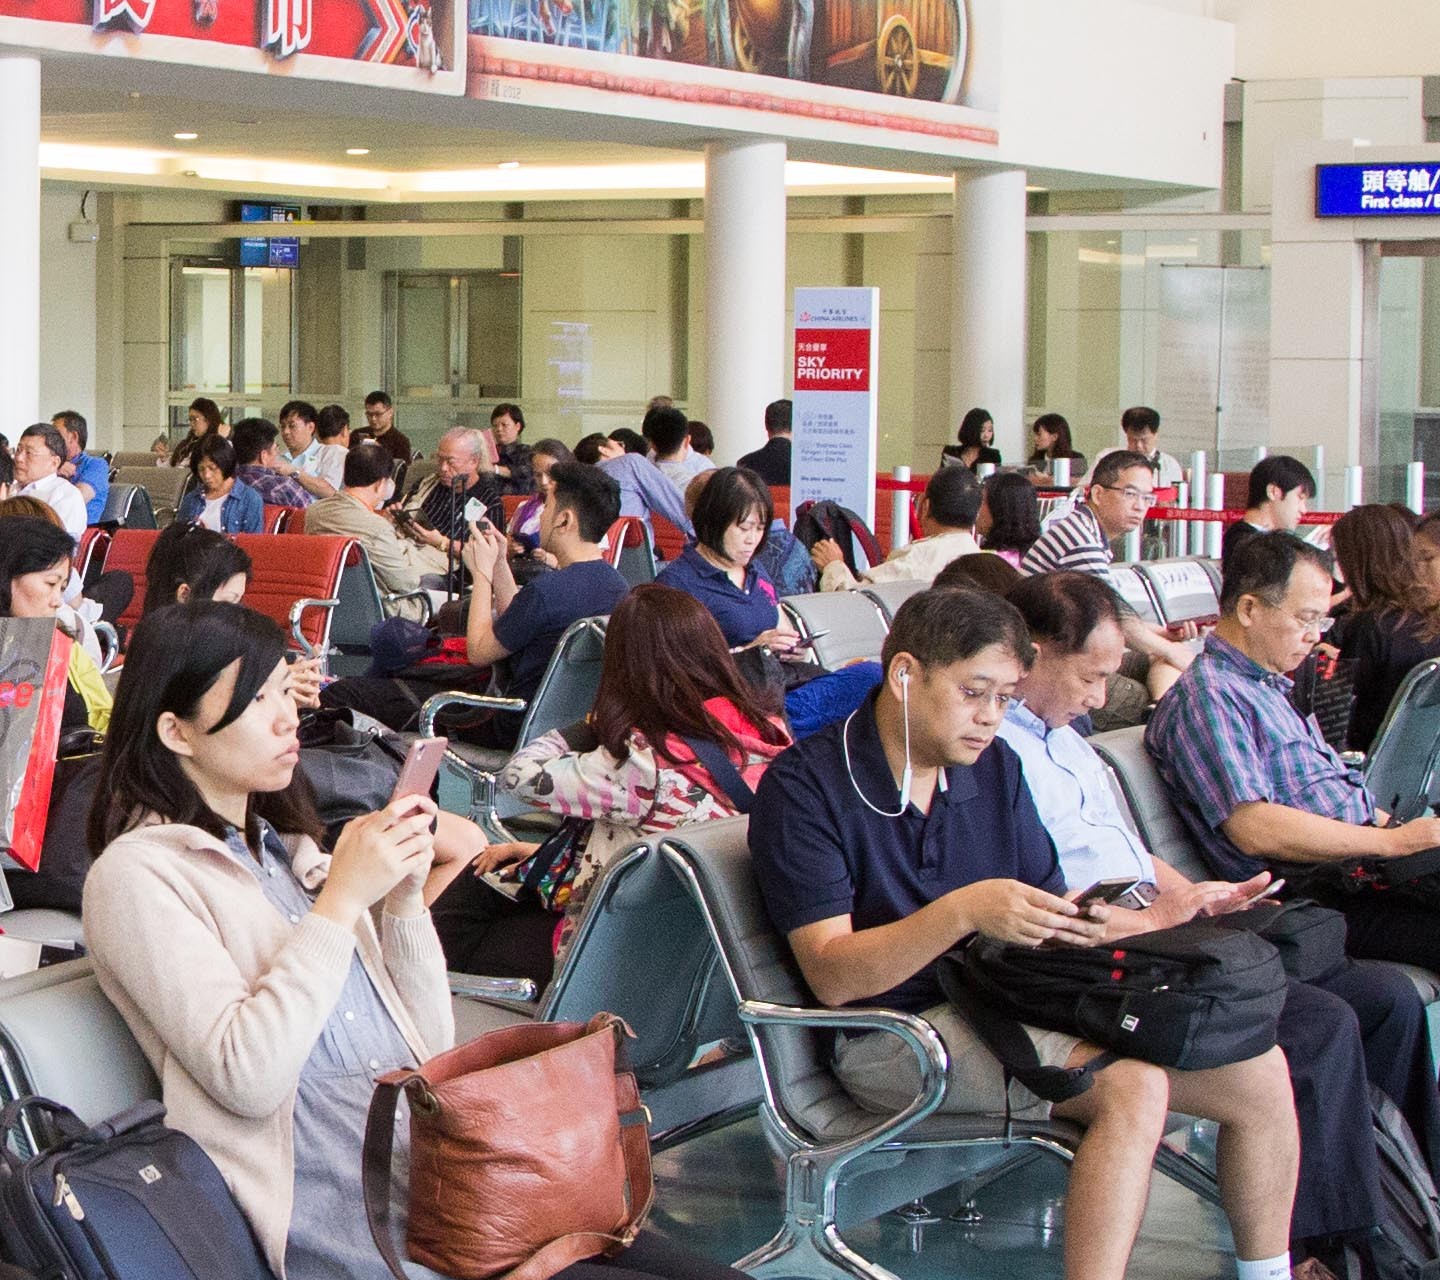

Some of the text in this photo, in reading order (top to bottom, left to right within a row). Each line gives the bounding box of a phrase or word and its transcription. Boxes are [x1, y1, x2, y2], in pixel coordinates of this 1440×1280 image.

[1361, 195, 1390, 209] First
[1391, 194, 1424, 208] class
[798, 356, 826, 367] SKY
[797, 368, 863, 380] PRIORITY
